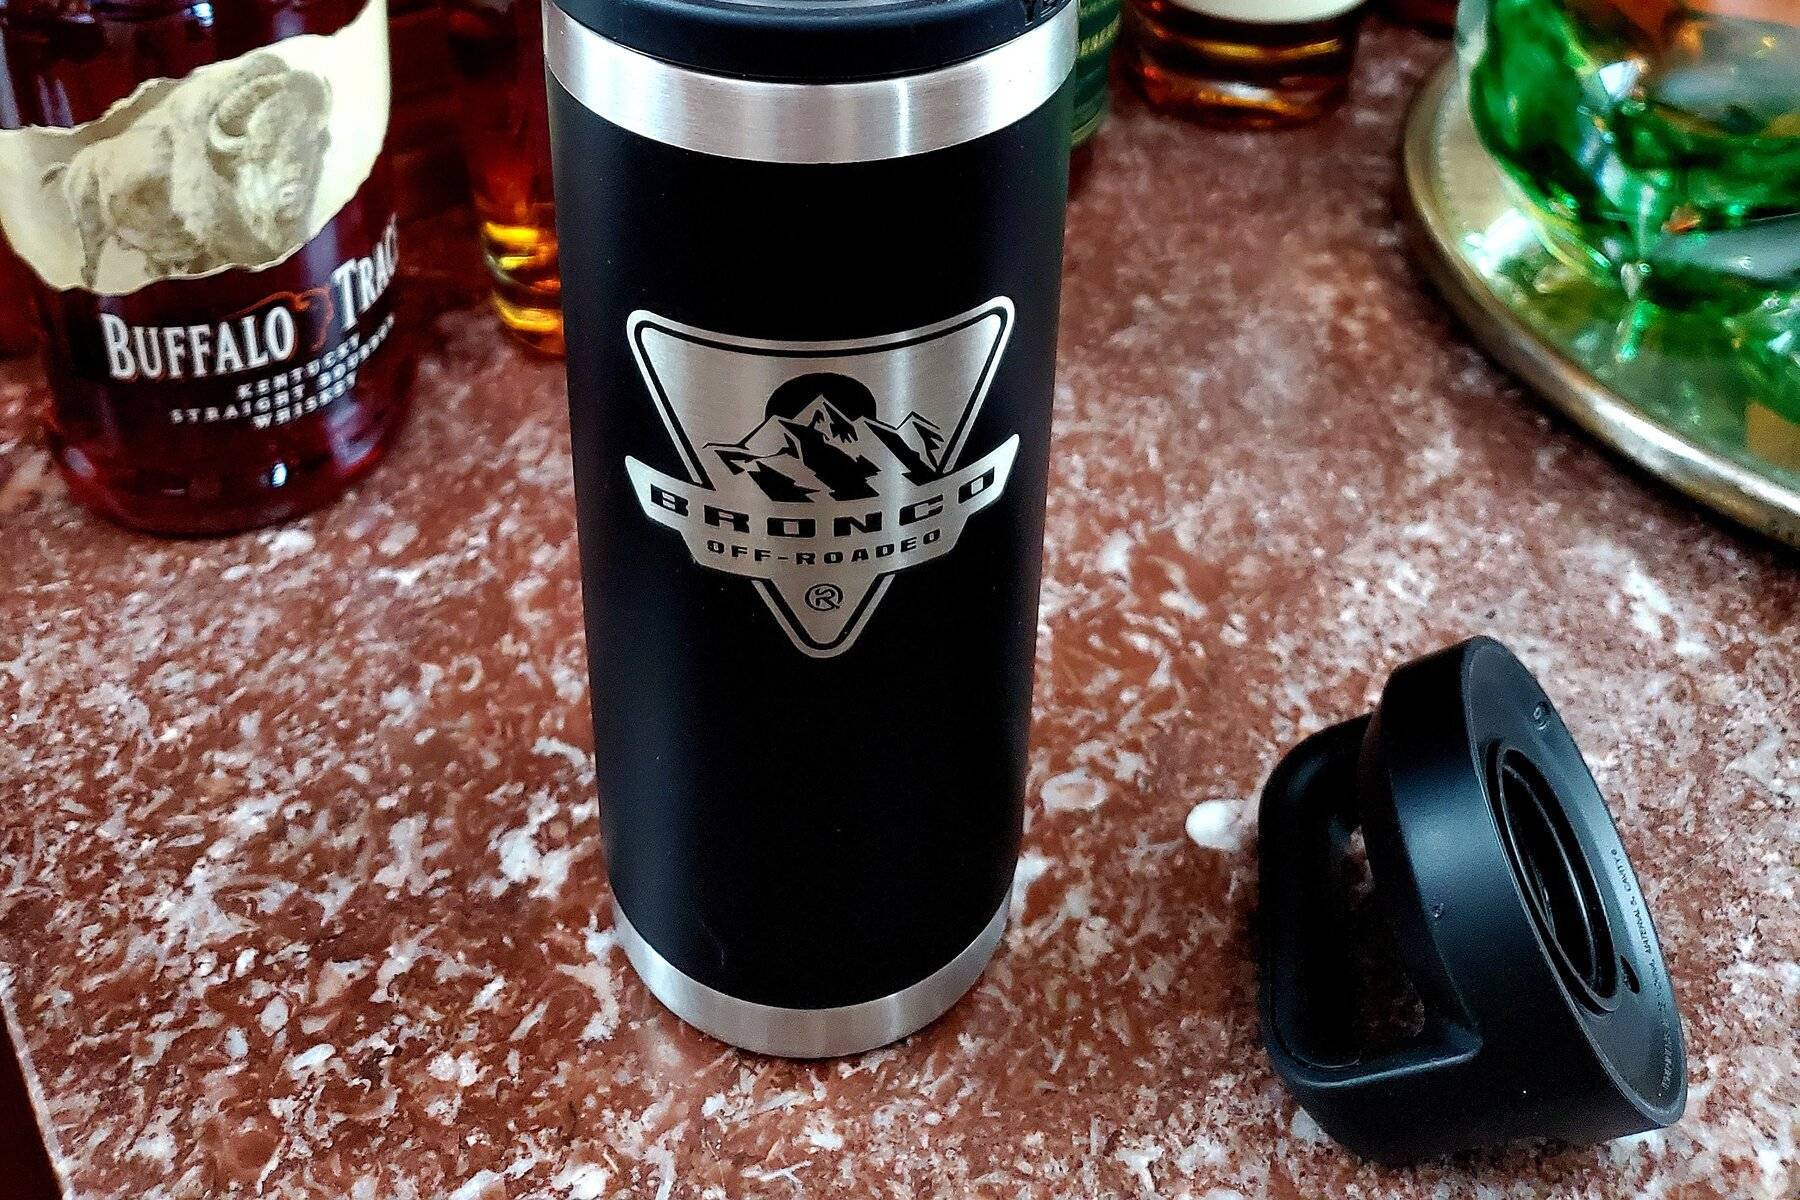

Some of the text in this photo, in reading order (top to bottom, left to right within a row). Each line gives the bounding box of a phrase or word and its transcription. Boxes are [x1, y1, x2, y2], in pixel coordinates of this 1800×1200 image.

[100, 211, 399, 381] BUFFALO TRAC
[236, 332, 360, 400] KENTUCKY
[169, 384, 305, 425] STRAIGHT
[252, 370, 358, 431] WHISKEY
[650, 466, 995, 539] BRONCO
[707, 528, 941, 567] OFF-ROADEO
